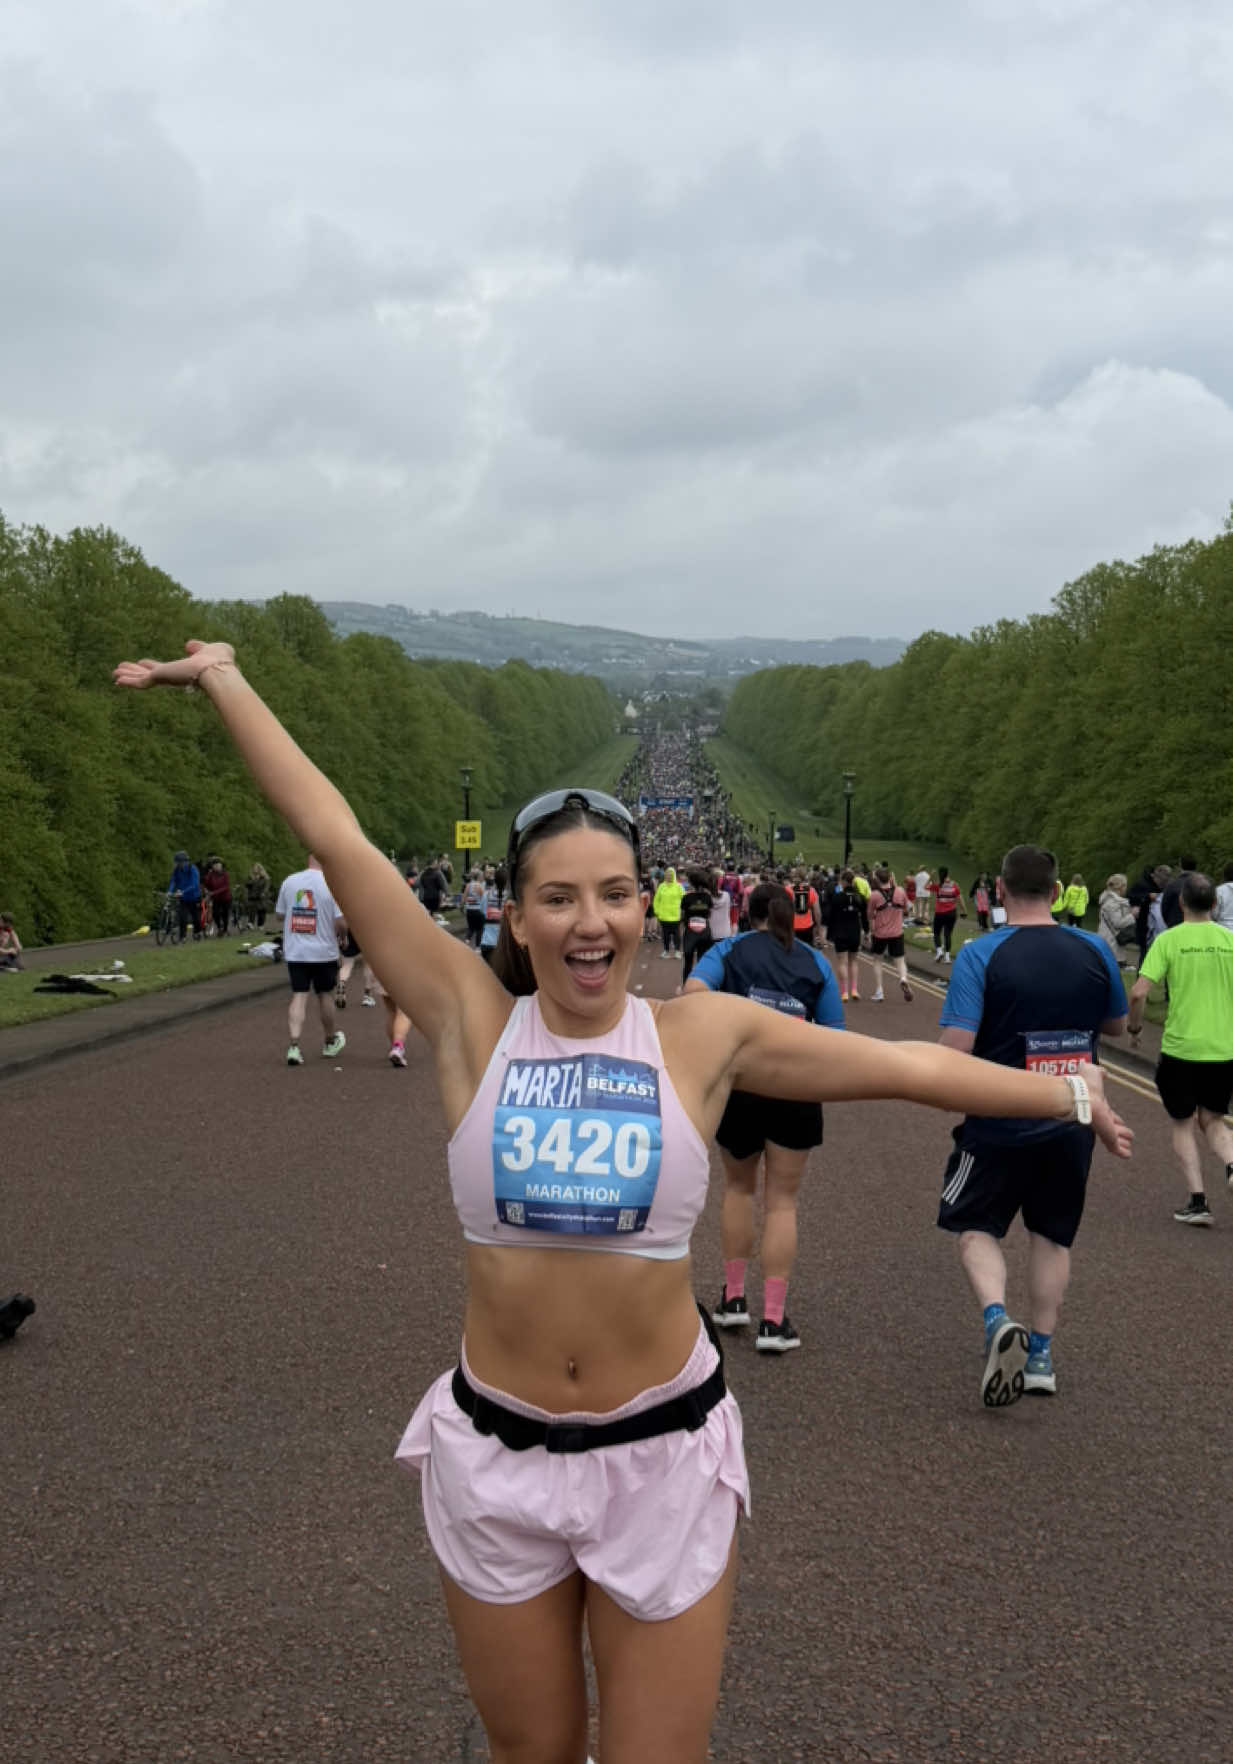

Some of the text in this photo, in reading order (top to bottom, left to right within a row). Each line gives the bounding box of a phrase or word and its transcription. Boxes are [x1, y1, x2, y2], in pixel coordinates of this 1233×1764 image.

[502, 1062, 583, 1108] MARIA
[586, 1076, 656, 1098] BELFAST
[501, 1116, 651, 1178] 3420
[525, 1183, 621, 1203] MARATHON
